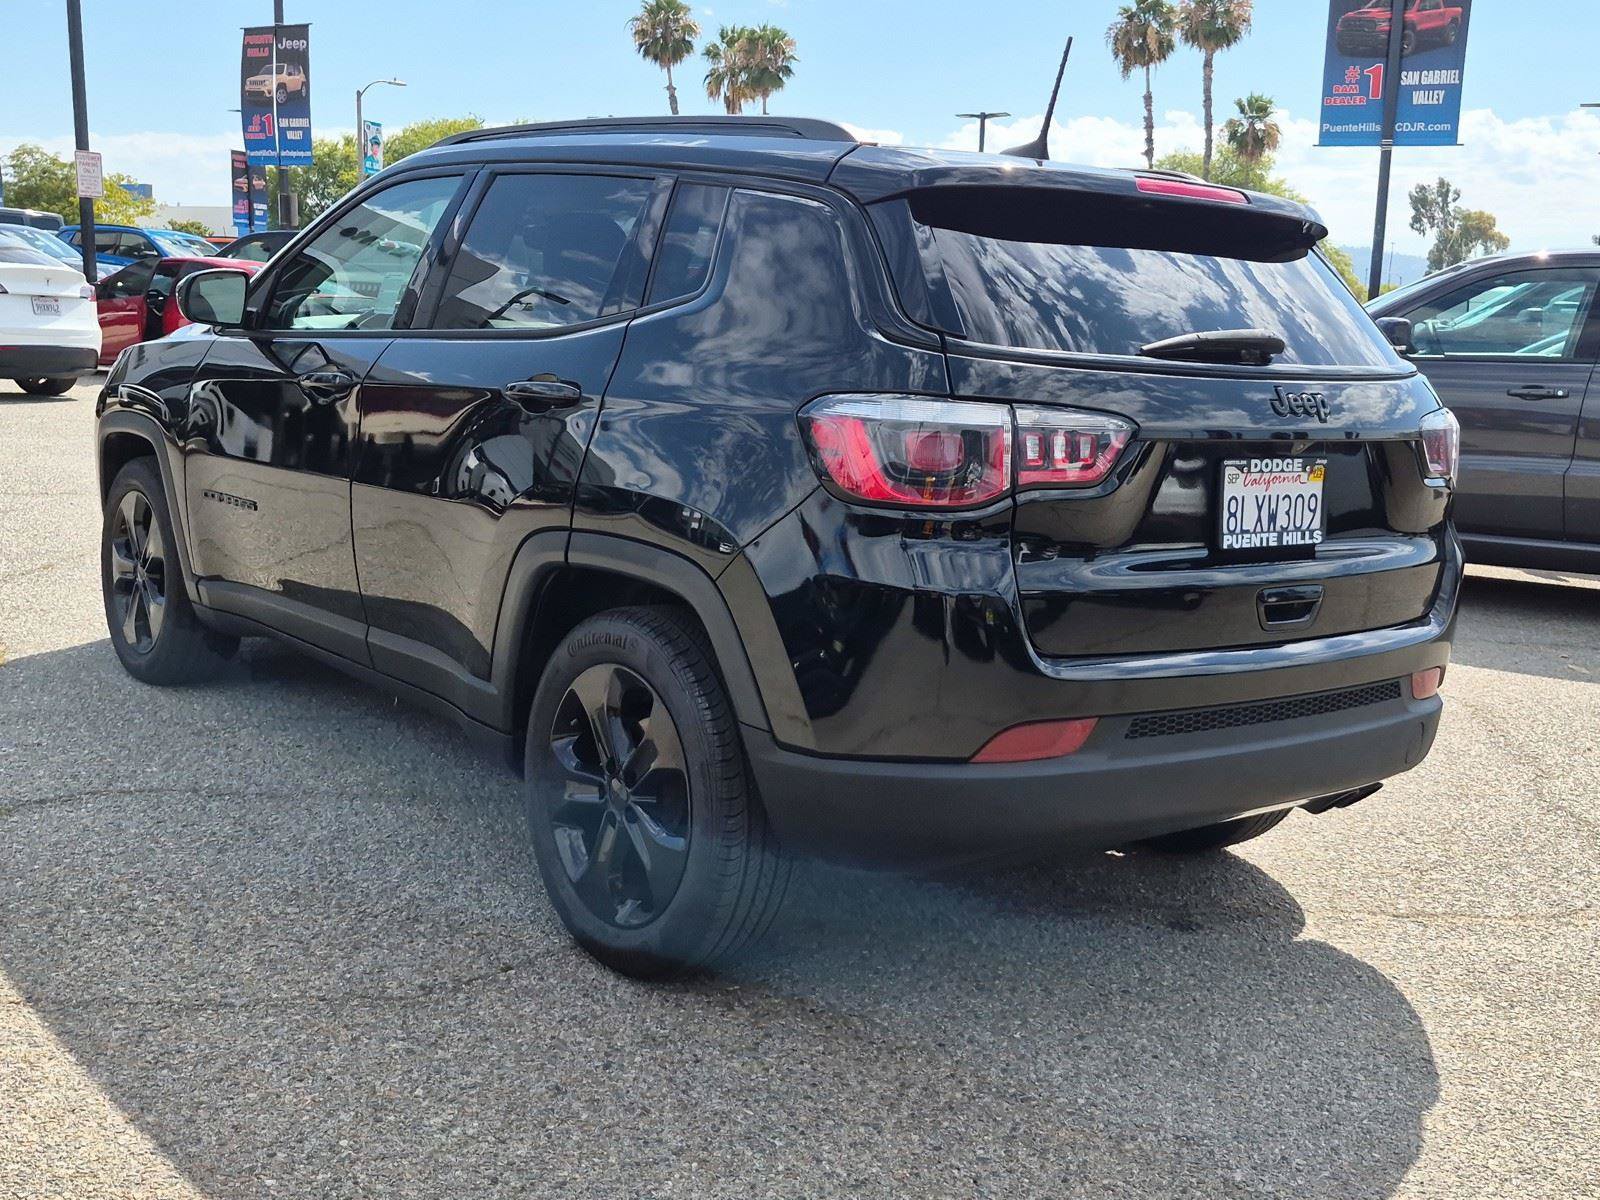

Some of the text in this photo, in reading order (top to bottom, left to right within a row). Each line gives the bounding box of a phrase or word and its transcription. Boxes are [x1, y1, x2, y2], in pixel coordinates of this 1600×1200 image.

[277, 37, 307, 51] Jeep
[1400, 69, 1460, 85] SAN GABRIEL
[1332, 84, 1360, 94] RAM
[1323, 96, 1367, 106] DEALER
[1412, 89, 1445, 105] VALLEY
[1322, 122, 1382, 133] PuenteHills
[1394, 122, 1451, 132] CDJR.com
[1269, 385, 1330, 423] Jeep
[1250, 458, 1303, 473] DODGE
[1226, 472, 1240, 485] SEP
[1226, 492, 1319, 534] 8LXW309
[1222, 529, 1323, 550] PUENTE HILLS
[566, 631, 627, 658] Continental
